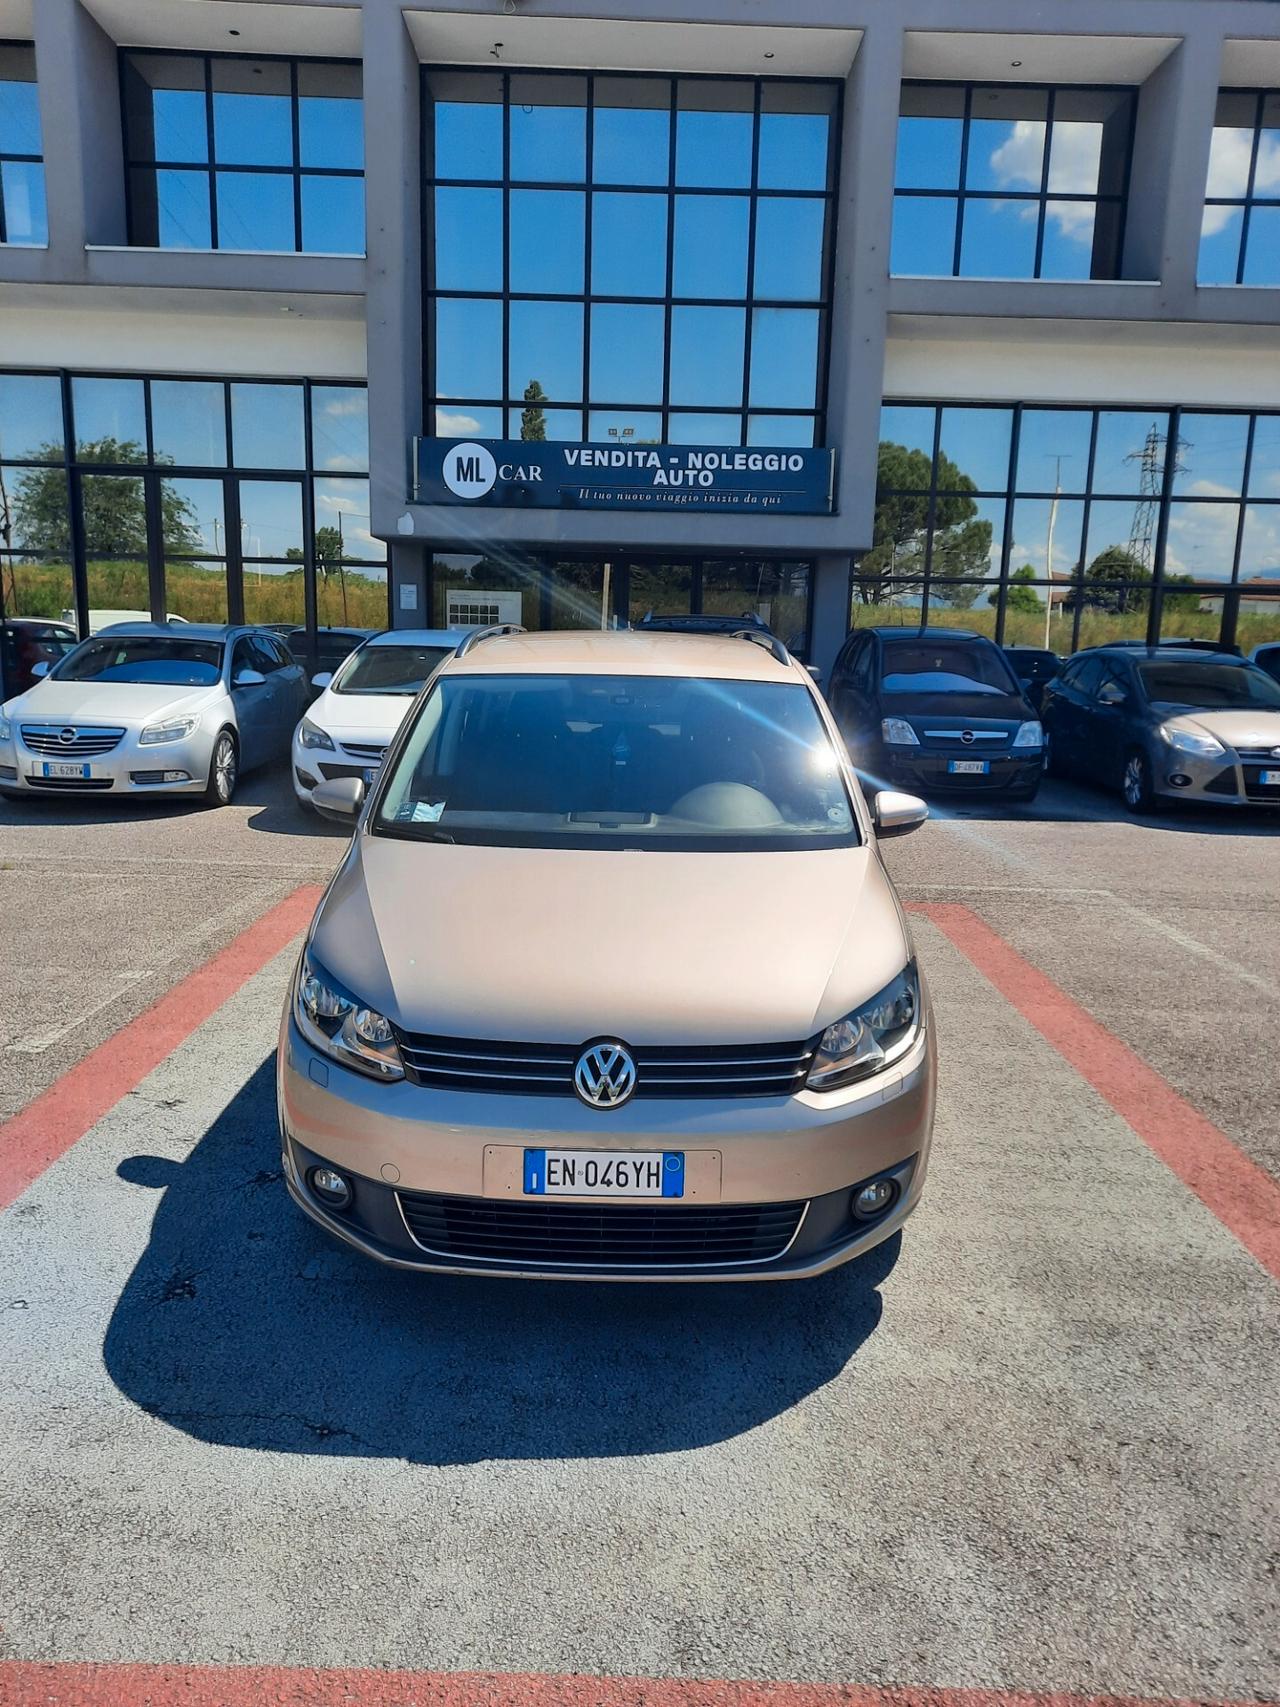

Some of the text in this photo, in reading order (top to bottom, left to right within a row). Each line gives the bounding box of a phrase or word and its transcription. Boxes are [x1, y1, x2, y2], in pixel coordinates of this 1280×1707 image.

[456, 457, 543, 482] ML CAR
[564, 449, 661, 468] VENDITA
[688, 452, 804, 471] NOLEGGIO
[653, 470, 714, 486] AUTO
[579, 489, 782, 507] Il tuo nuovo viaggio inizia da qui
[547, 1159, 575, 1186] EN
[585, 1160, 660, 1188] 046YH
